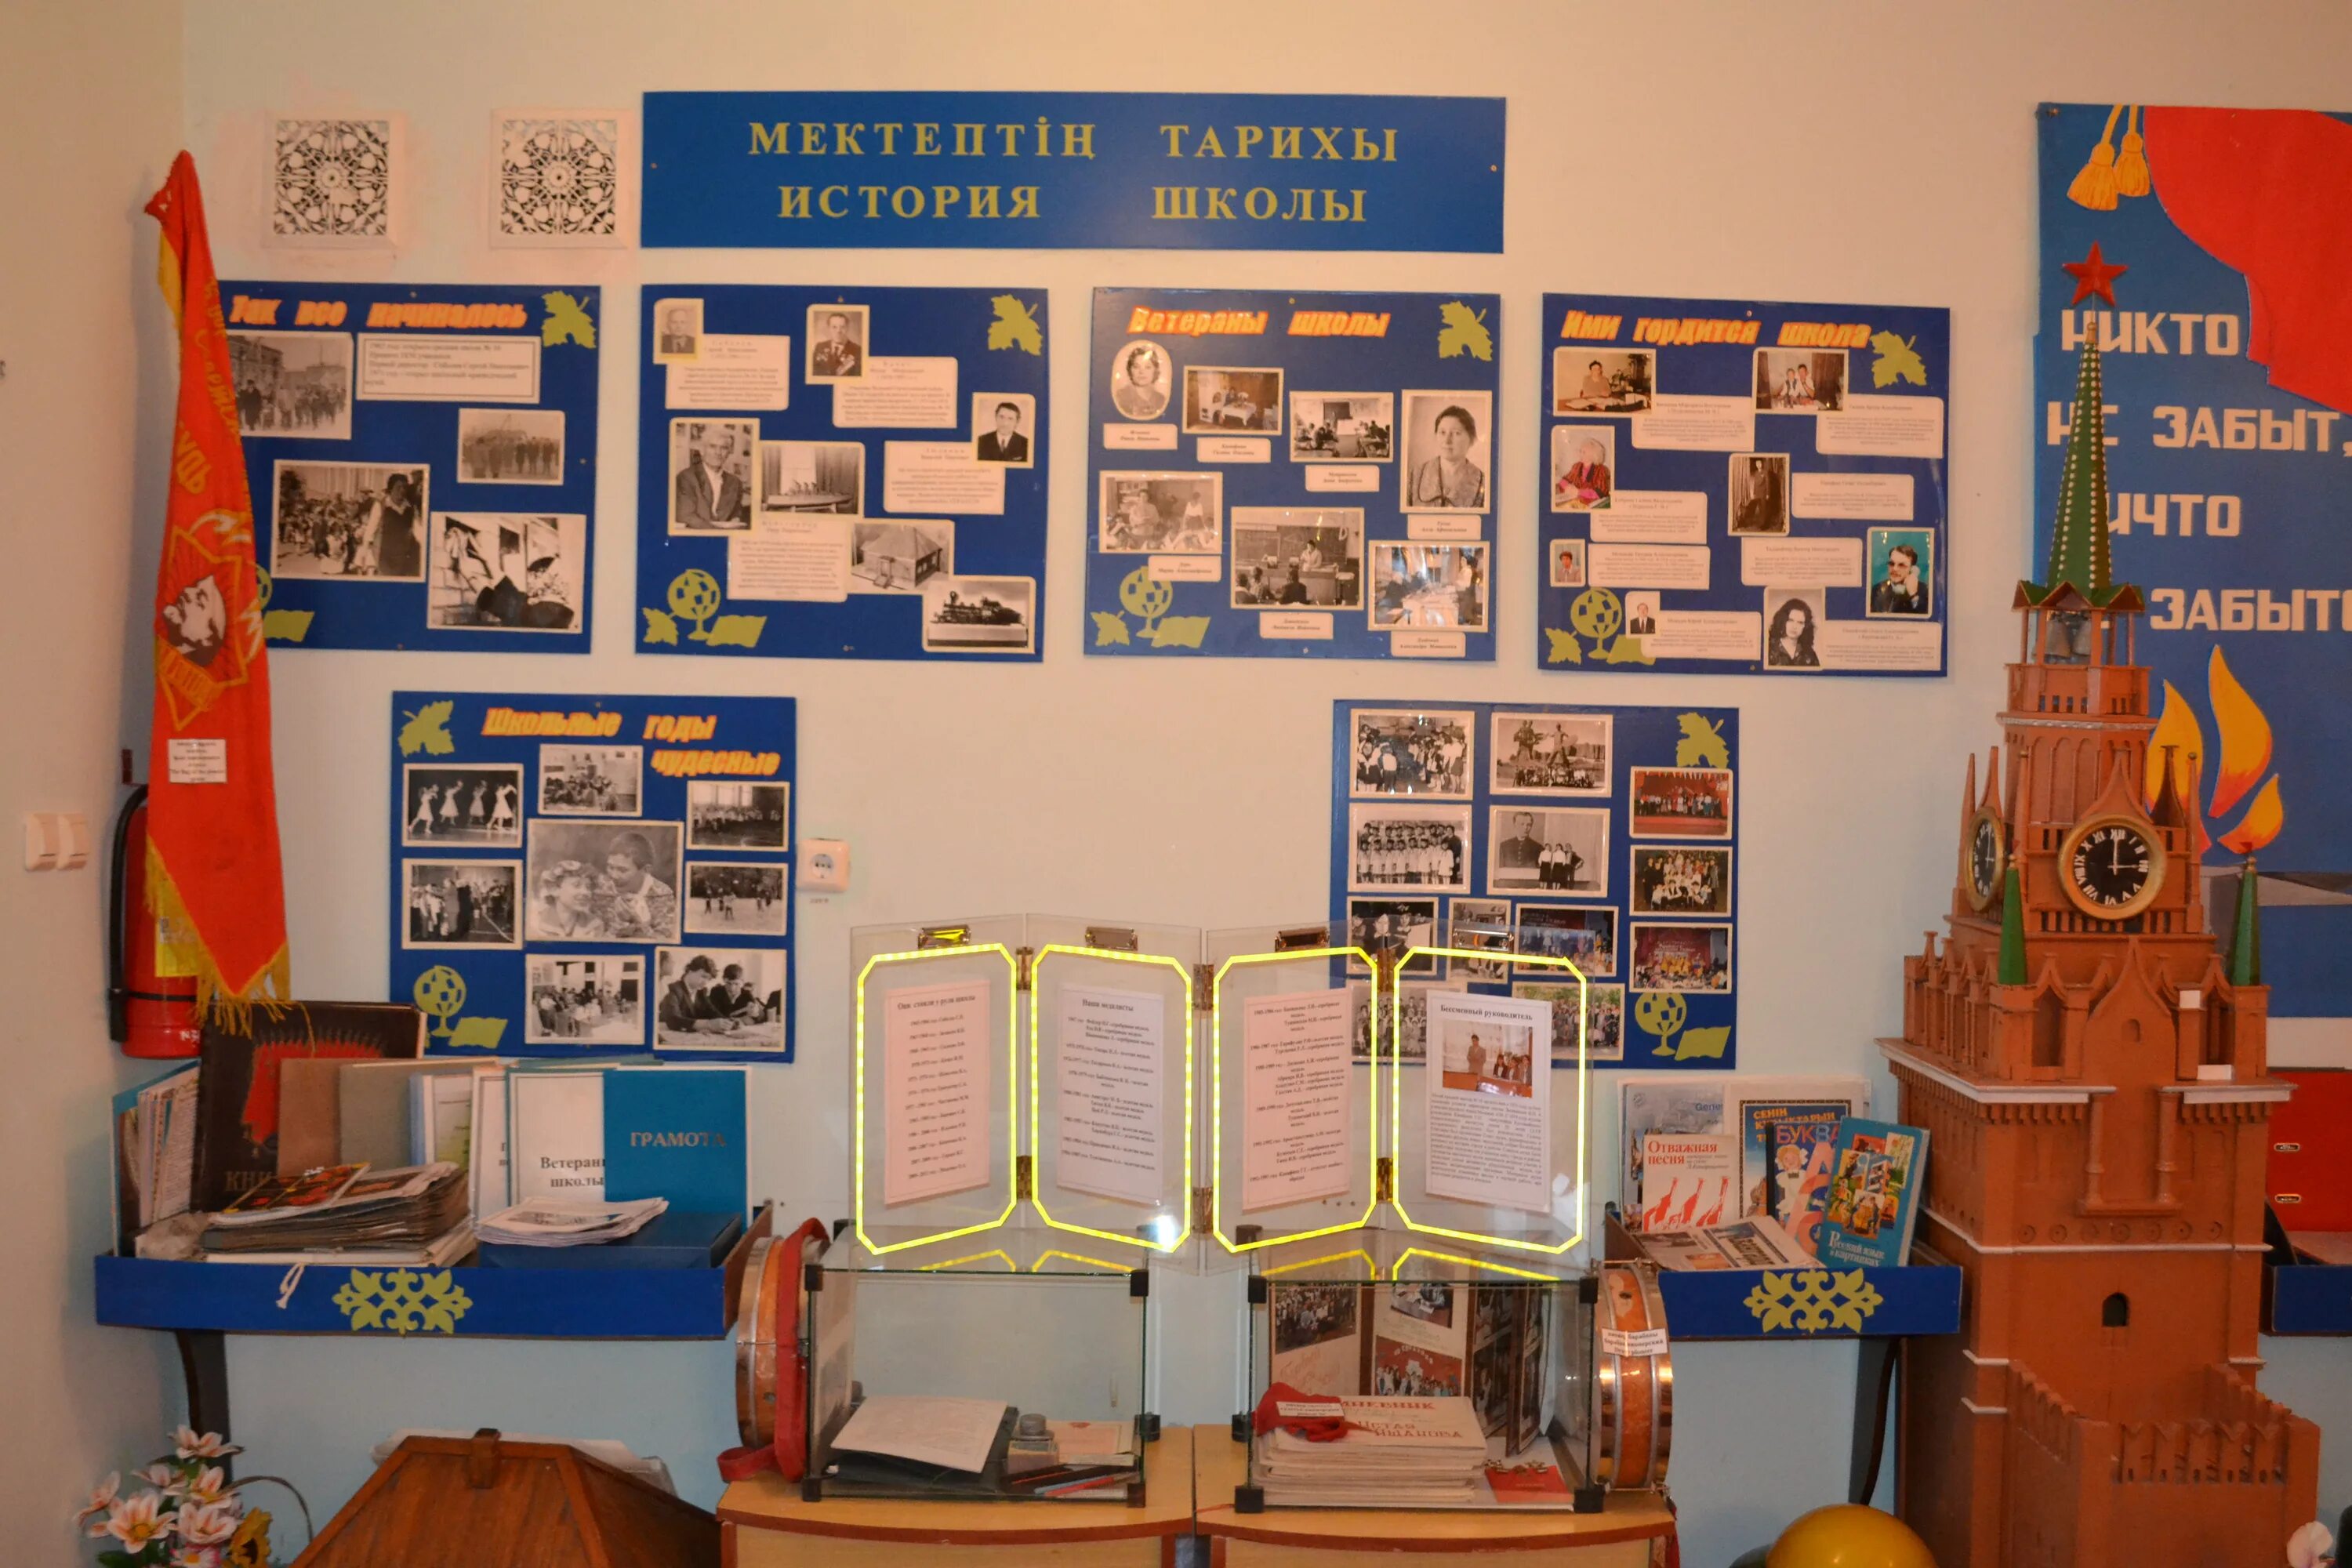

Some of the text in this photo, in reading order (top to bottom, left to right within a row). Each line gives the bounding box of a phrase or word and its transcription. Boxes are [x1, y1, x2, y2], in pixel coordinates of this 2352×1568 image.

[1160, 124, 1398, 162] ТАРИХЫ
[779, 185, 1367, 223] ИСТОРИЯ ШКОЛЫ
[1126, 305, 1392, 338] Ветераны школы
[1560, 310, 1874, 348] Ими гордится школа
[2061, 310, 2240, 356] НИКТО
[2107, 492, 2241, 537] ИЧТО
[481, 707, 717, 743] Школьные годы
[651, 749, 782, 777] чудесные
[1441, 1004, 1533, 1021] Бессменный руководитель
[630, 1131, 726, 1148] ГРАМОТА
[1647, 1141, 1719, 1154] Отважная
[1648, 1155, 1685, 1165] песня
